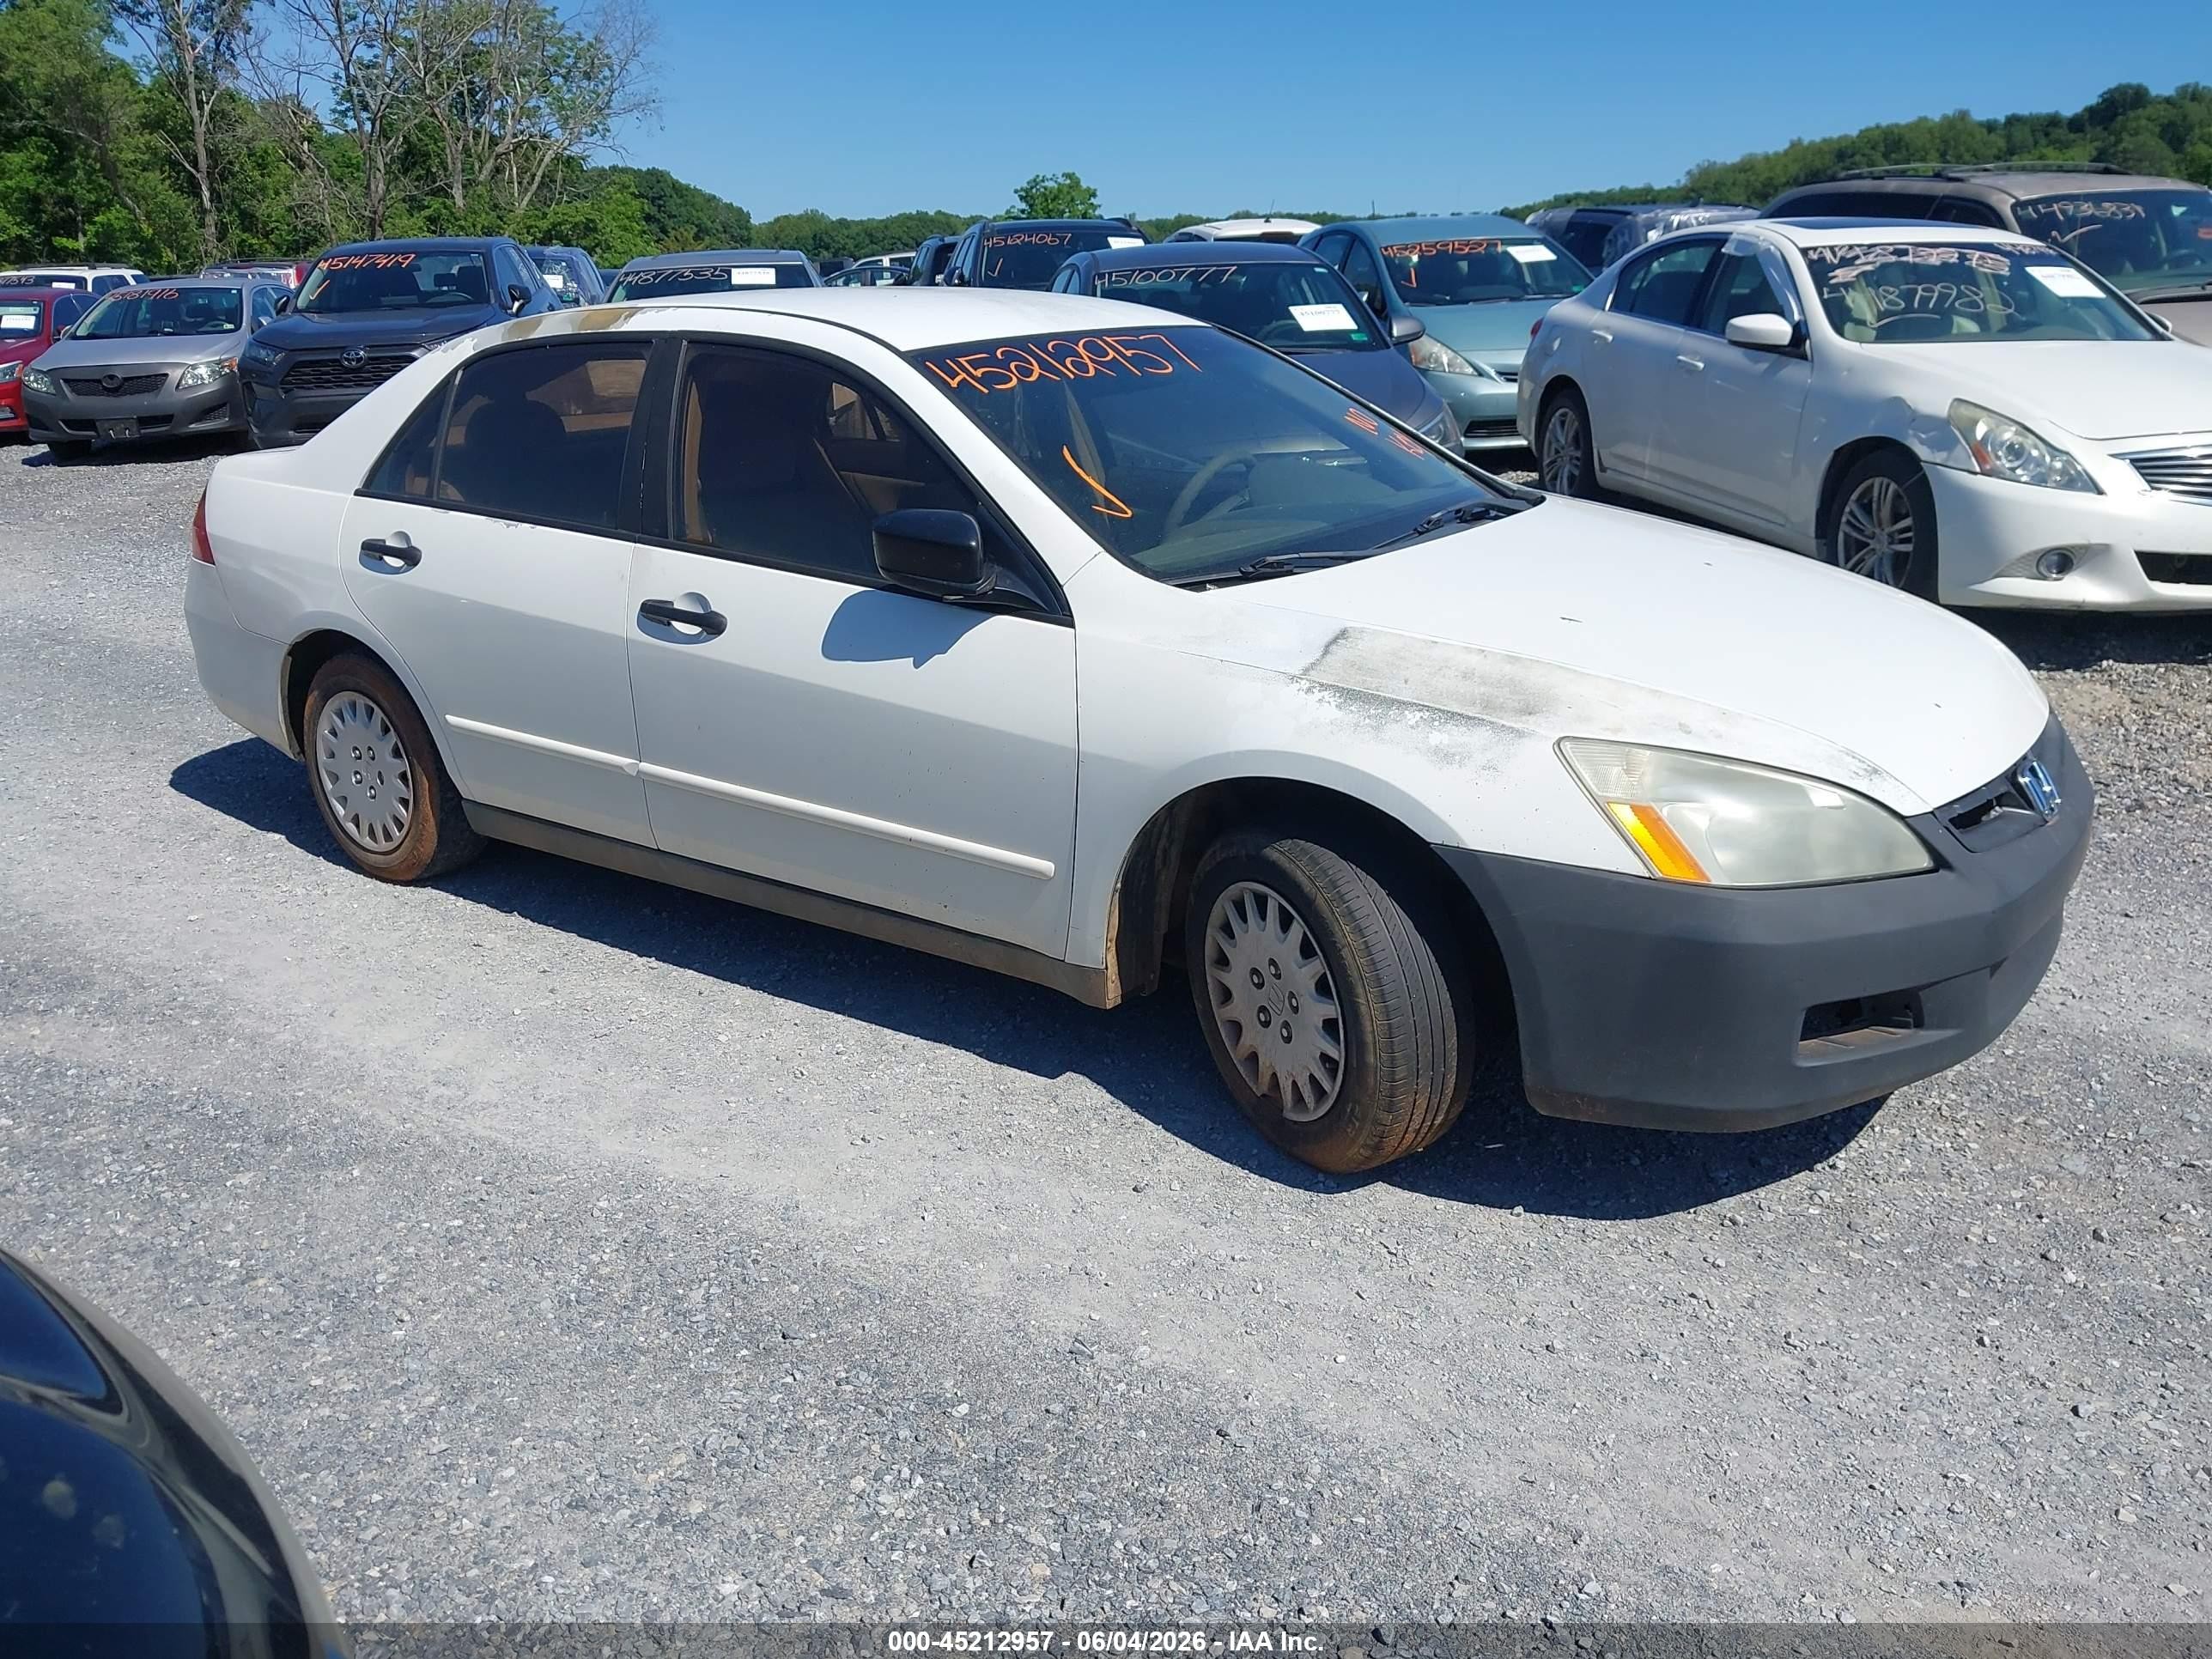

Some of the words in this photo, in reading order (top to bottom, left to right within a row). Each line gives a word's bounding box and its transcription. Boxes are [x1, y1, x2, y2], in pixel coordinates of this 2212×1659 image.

[983, 233, 1073, 248] 45124067
[1381, 240, 1502, 258] 45259527
[318, 253, 416, 270] 45147419
[618, 267, 729, 286] 44877535
[1094, 265, 1237, 289] 45100777
[925, 334, 1204, 394] 45212957
